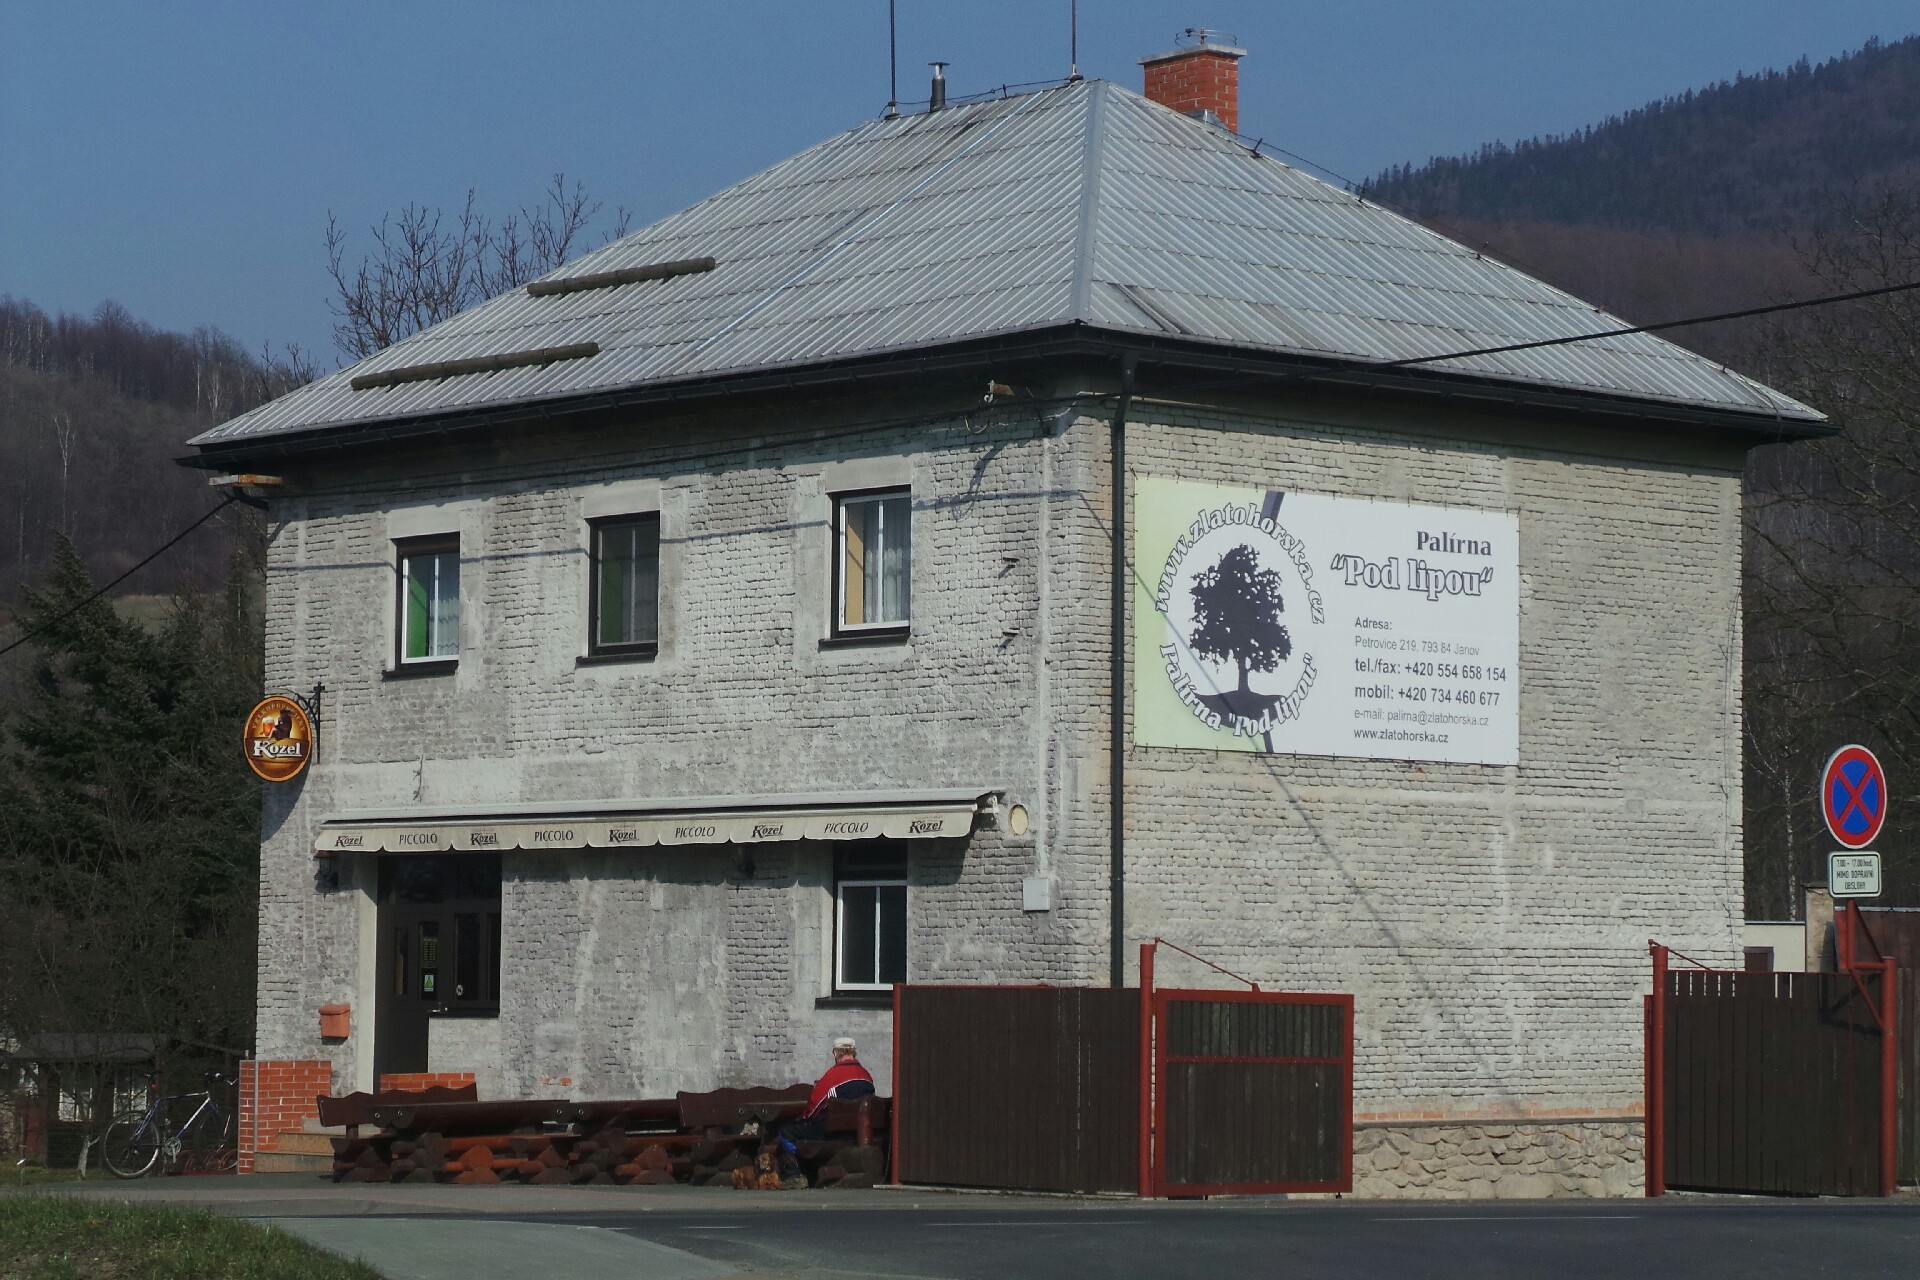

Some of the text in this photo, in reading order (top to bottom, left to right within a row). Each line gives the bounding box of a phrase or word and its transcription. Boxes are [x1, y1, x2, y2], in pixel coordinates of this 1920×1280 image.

[1416, 530, 1493, 556] Palírna
[1155, 502, 1325, 624] www.zlatohorska.cz
[1354, 616, 1392, 630] Adresa:
[1355, 636, 1480, 656] Petrovice 219, 793 84 Janov
[1355, 658, 1506, 682] tel./fax: +420 554 658 154
[1160, 642, 1222, 732] Palírna
[1355, 684, 1500, 706] mobil: +420 734 460 677
[1354, 708, 1385, 720] e-mail:
[1354, 728, 1449, 744] www.zlatohorska.cz
[252, 740, 302, 759] Kozel
[334, 820, 944, 848] Kozel PICCOLO Kozel PICCOLO Kozel PICCOLO Kozel PICCOLO Kozel
